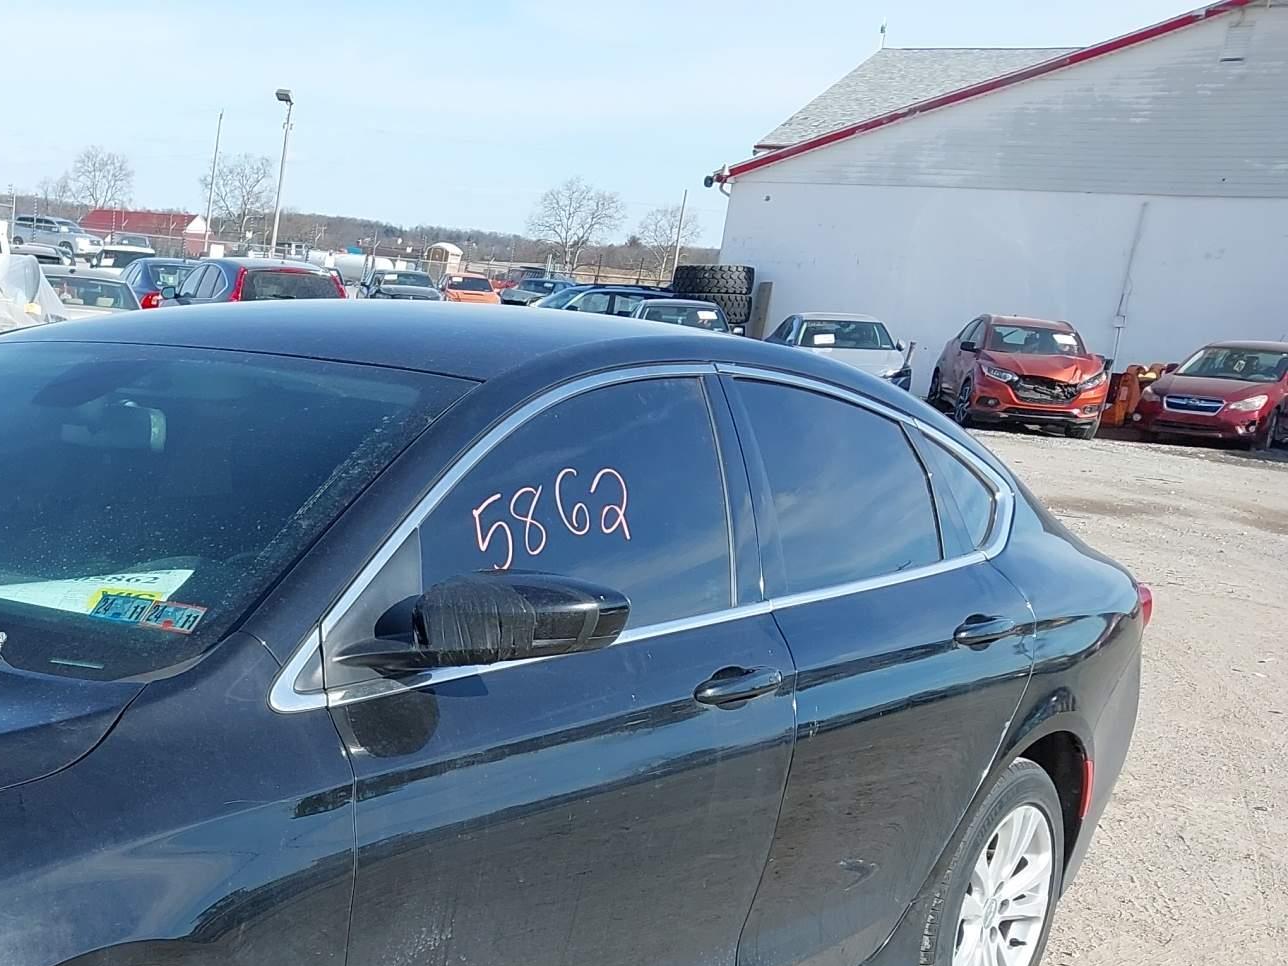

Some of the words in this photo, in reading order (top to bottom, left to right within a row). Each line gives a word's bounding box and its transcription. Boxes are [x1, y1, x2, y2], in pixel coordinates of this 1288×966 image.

[472, 467, 631, 570] 5862
[96, 598, 112, 615] 24
[147, 604, 168, 621] 24
